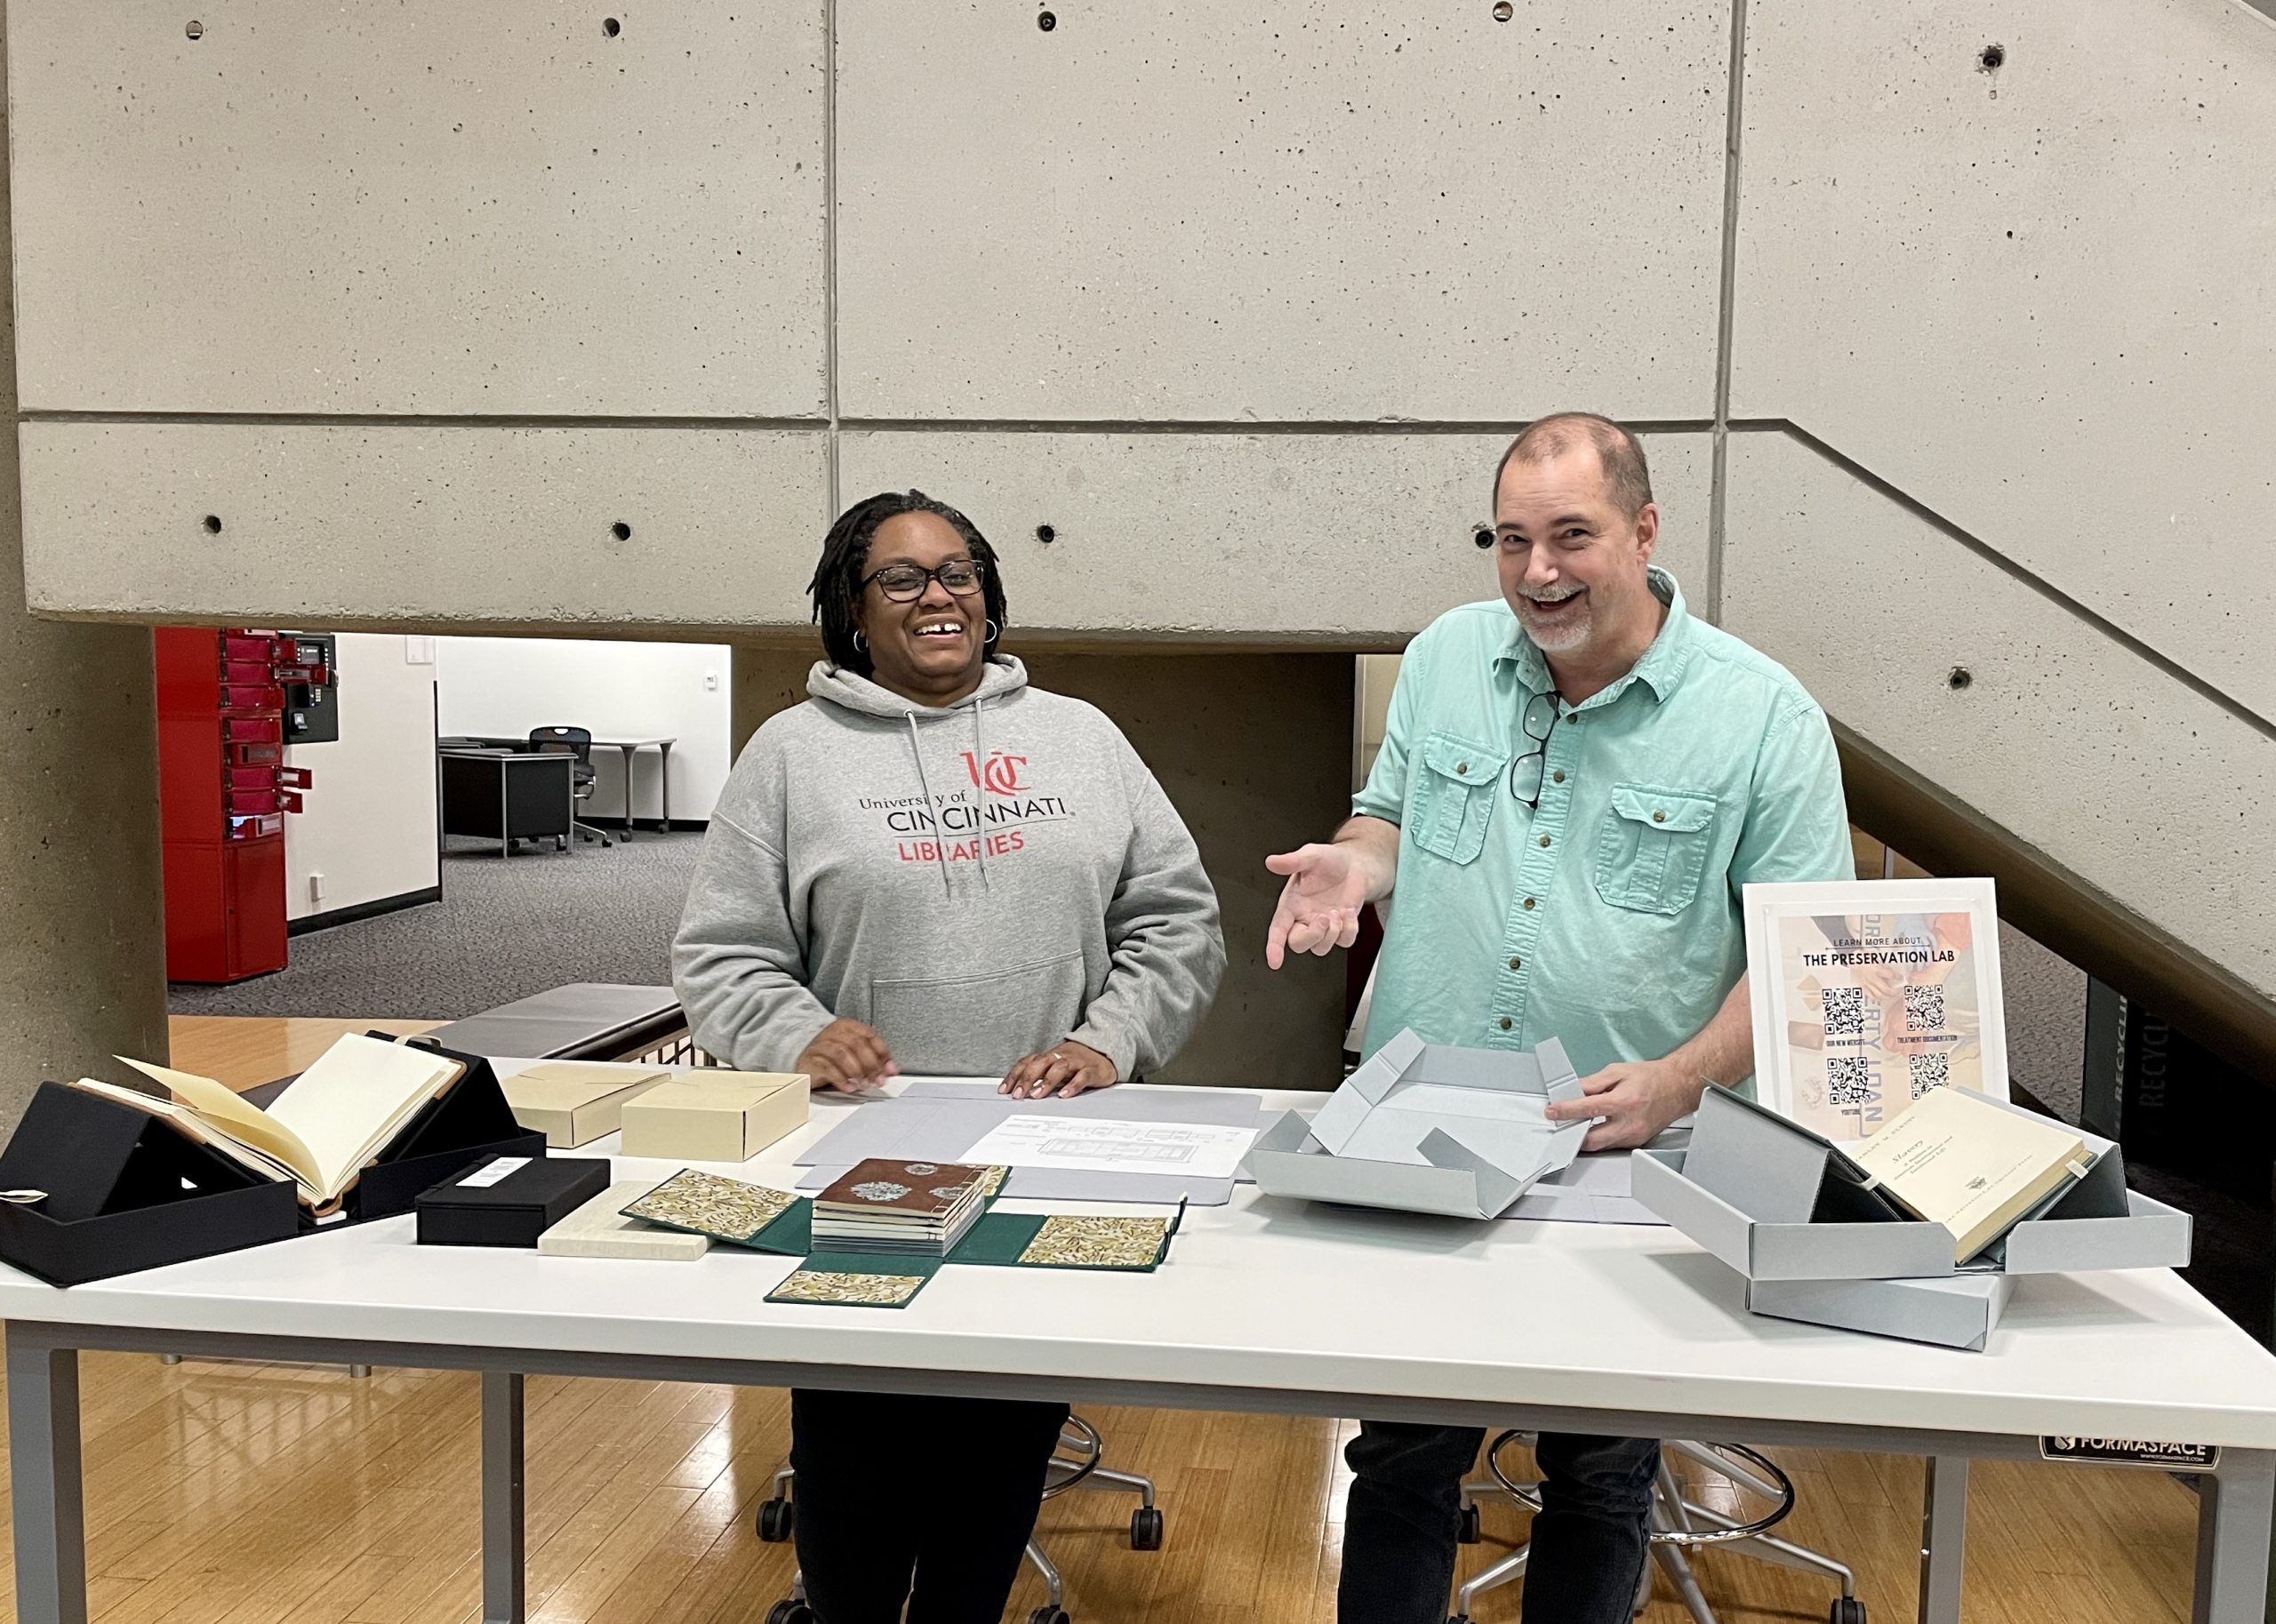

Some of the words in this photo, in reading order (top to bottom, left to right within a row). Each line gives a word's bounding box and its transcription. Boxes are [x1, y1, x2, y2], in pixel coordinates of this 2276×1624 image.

[860, 792, 944, 810] Universiy
[950, 789, 966, 803] of
[887, 797, 1066, 832] CINCINNATI
[1833, 939, 1862, 947] LEARN
[1865, 938, 1890, 946] MORE
[1893, 937, 1921, 945] ABOUT
[1803, 954, 1828, 966] THE
[1831, 951, 1928, 965] PRESERVATION
[1931, 950, 1955, 963] LAB
[2138, 1012, 2170, 1108] RECYCL
[2080, 1438, 2207, 1456] FORMASPACE
